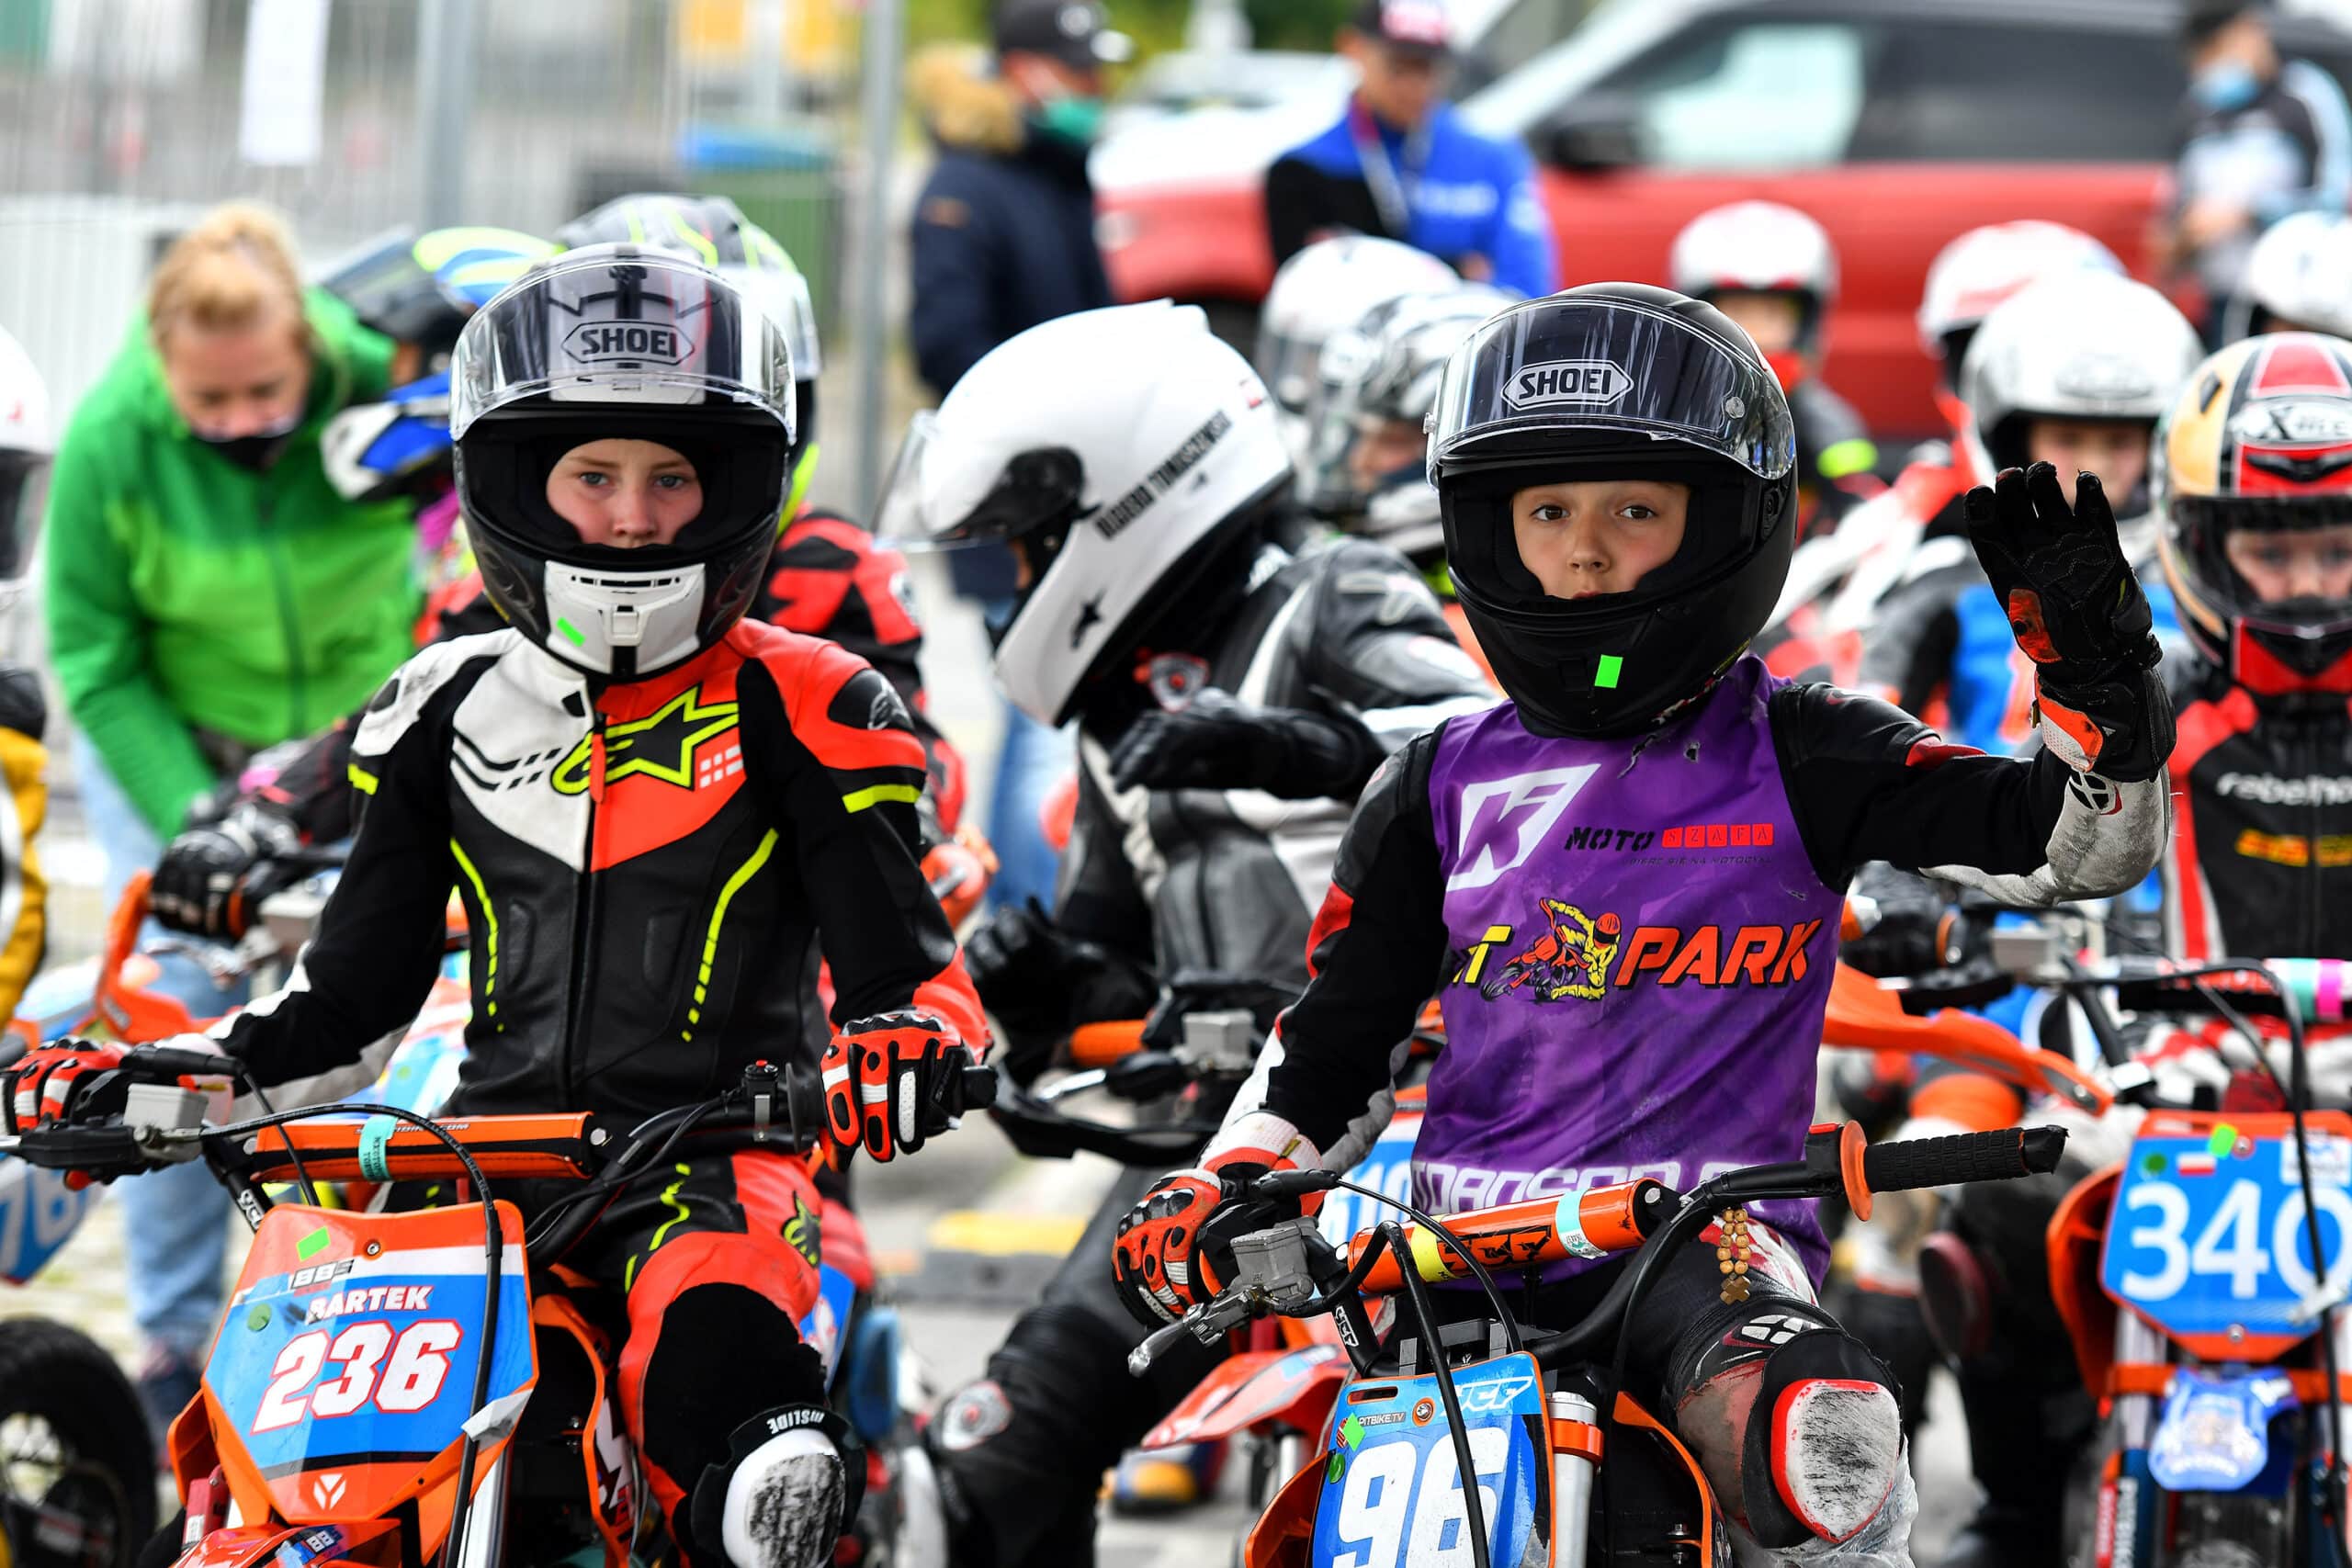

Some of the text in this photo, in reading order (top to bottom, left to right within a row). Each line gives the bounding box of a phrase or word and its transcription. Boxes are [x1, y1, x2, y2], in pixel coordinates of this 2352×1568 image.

[581, 328, 677, 357] SHOEI
[1518, 367, 1611, 400] SHOEI
[1564, 824, 1772, 852] MOTO SZAFA
[1612, 919, 1823, 989] PARK
[2120, 1179, 2352, 1302] 340
[305, 1285, 435, 1325] BARTEK
[249, 1318, 465, 1437] 236
[1332, 1427, 1510, 1568] 96
